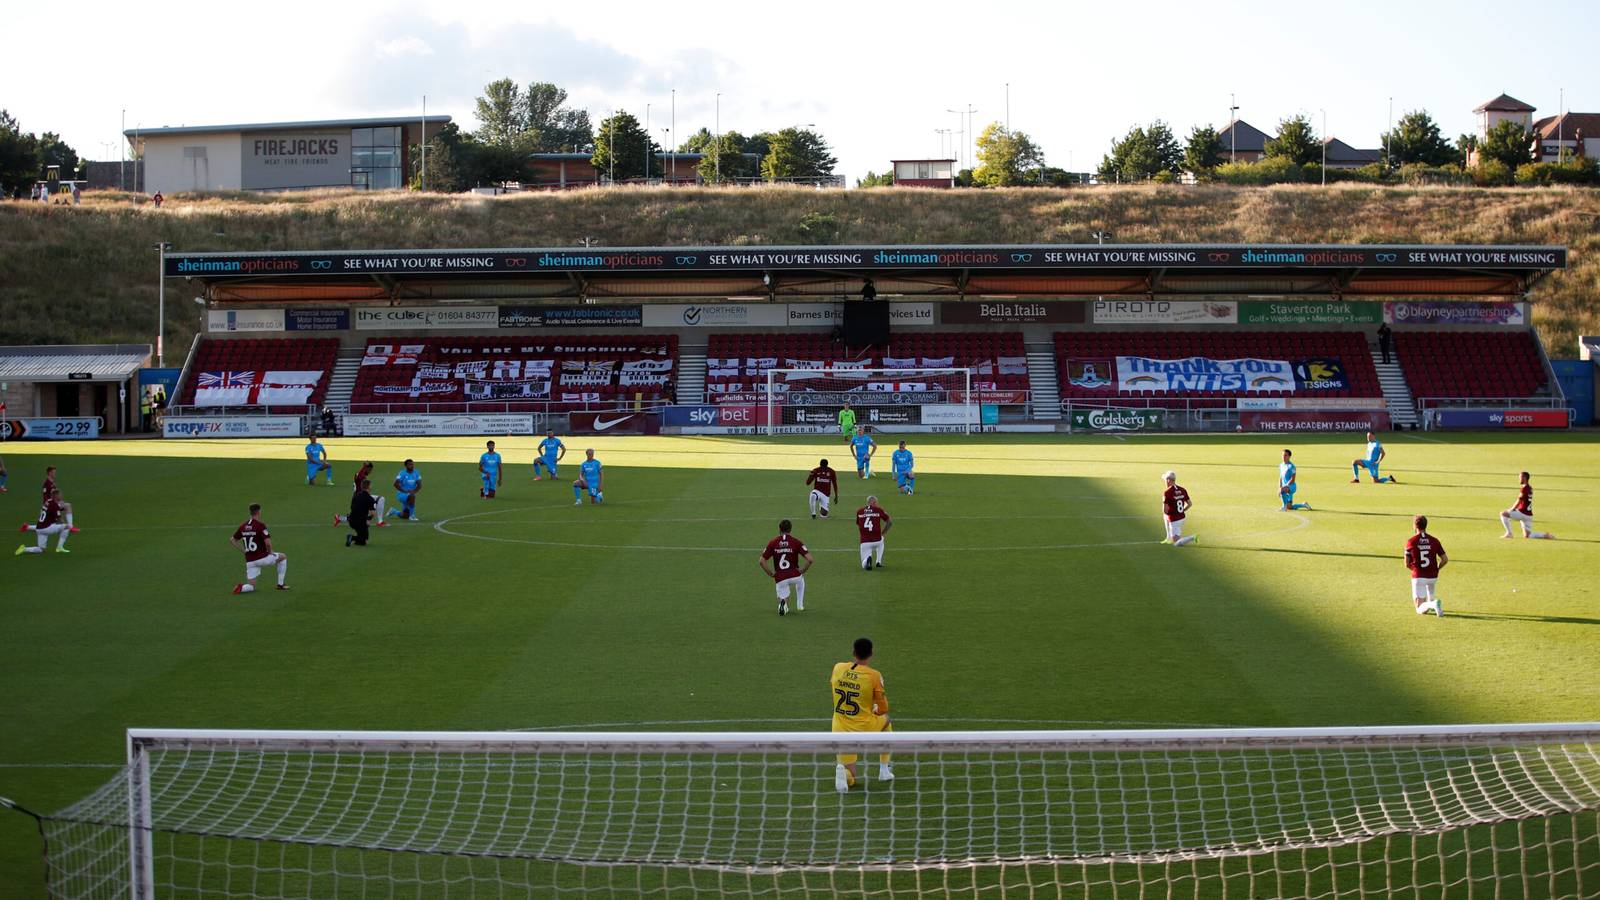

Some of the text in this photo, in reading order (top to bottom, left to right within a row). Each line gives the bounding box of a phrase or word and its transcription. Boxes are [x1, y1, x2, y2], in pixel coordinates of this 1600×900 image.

[254, 139, 338, 156] FIREJACKS
[344, 257, 494, 269] SEE WHAT YOU'RE MISSING
[537, 253, 664, 268] sheinmanopticians
[709, 253, 862, 265] SEE WHAT YOU'RE MISSING
[874, 251, 999, 266] sheinmanopticians
[1044, 252, 1196, 262] SEE WHAT YOU'RE MISSING
[1241, 251, 1365, 266] sheinmanopticians
[1408, 253, 1555, 263] SEE WHAT YOU'RE MISSING
[178, 258, 299, 272] sheinmanopticians
[358, 311, 424, 320] the cube
[544, 309, 641, 318] www.fabtronic.co.uk
[790, 310, 822, 319] Barnes
[916, 309, 930, 318] Ltd
[980, 304, 1047, 317] Bella Italia
[1270, 304, 1351, 314] Staverton Park
[1410, 303, 1511, 318] blayneypartnership
[438, 312, 463, 320] 01604
[1271, 315, 1306, 323] Weddings
[1312, 315, 1345, 323] Meetings
[1126, 358, 1283, 373] THANK YOU
[1170, 374, 1242, 391] NHS
[1304, 380, 1341, 389] T3SIGNS
[689, 408, 750, 424] sky bet
[1088, 410, 1145, 429] Carlsberg
[1489, 414, 1533, 423] sky sports
[1260, 422, 1371, 430] THE PTS ACADEMY STADIUM
[1176, 500, 1184, 513] 8
[863, 517, 874, 532] 4
[242, 536, 258, 552] 16
[779, 553, 790, 570] 6
[1420, 550, 1430, 568] 5
[839, 681, 860, 691] ARNOLD
[835, 688, 861, 717] 25
